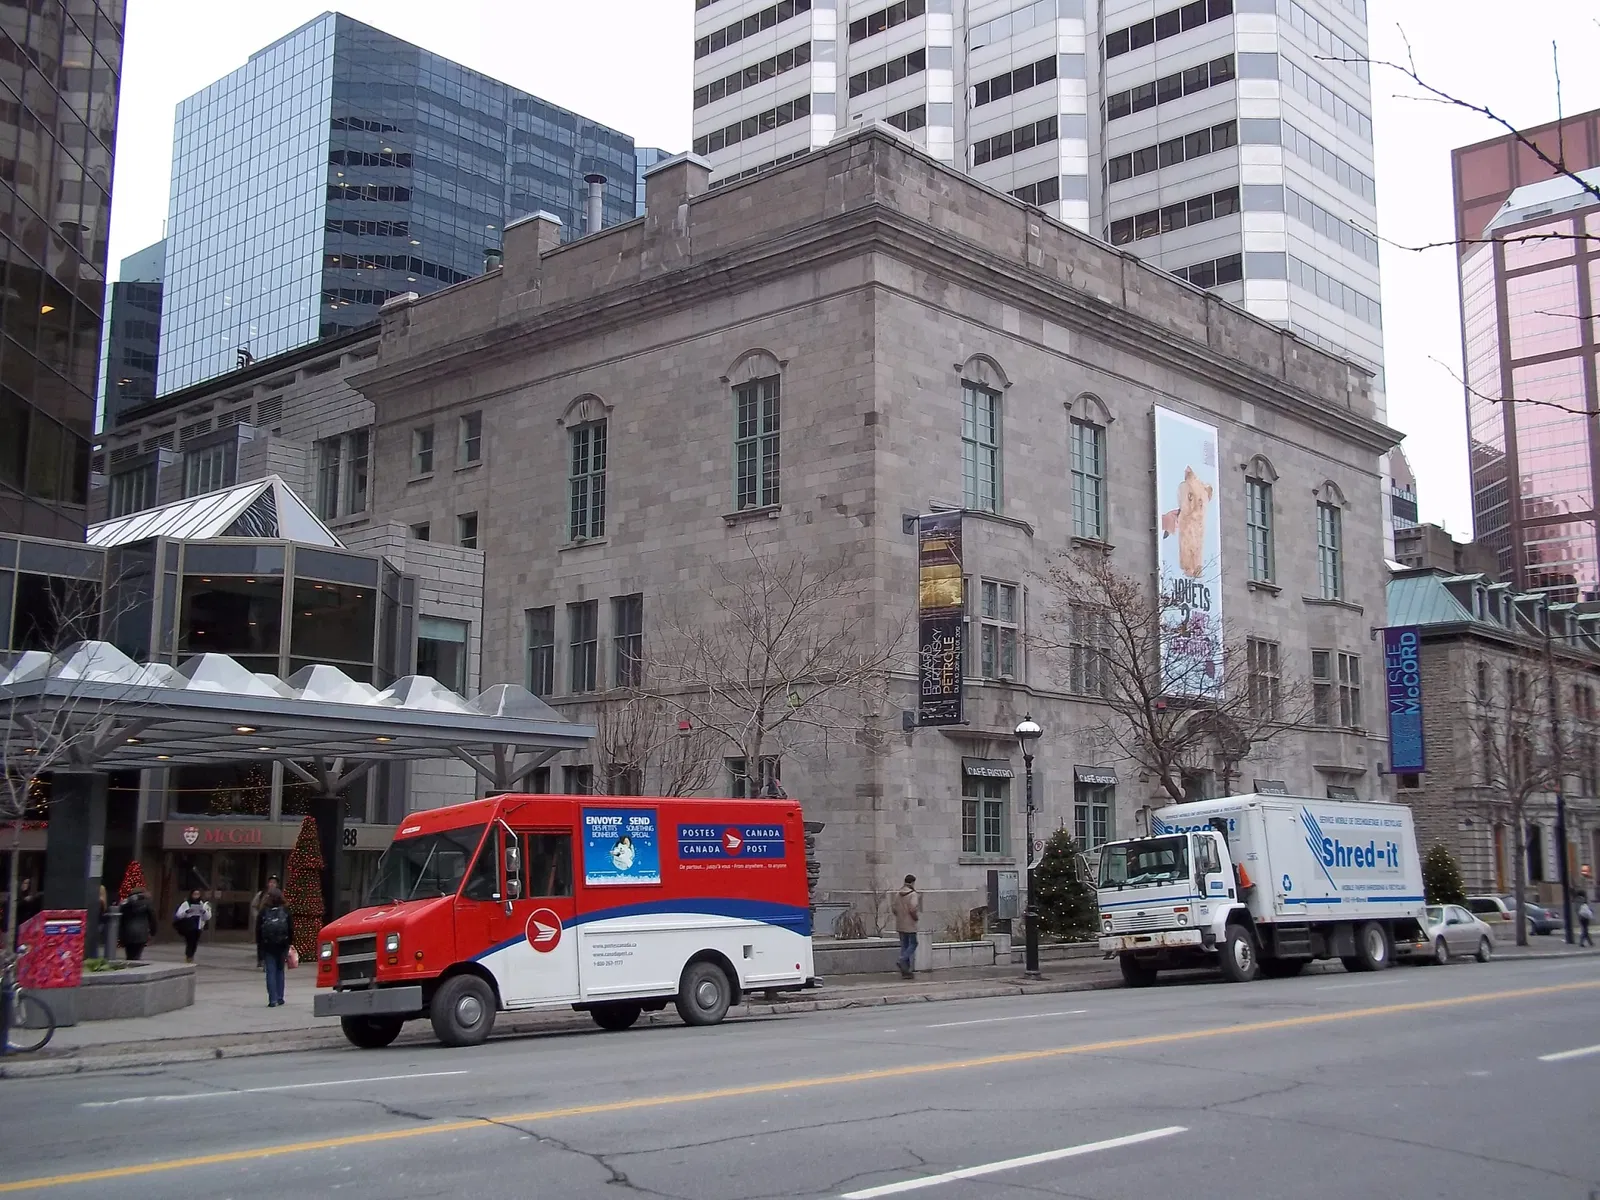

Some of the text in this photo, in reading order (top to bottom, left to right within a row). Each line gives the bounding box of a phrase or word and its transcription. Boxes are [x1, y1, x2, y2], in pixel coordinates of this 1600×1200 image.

[1172, 578, 1211, 612] JOUETS
[922, 644, 933, 695] EDWARD
[1400, 632, 1420, 715] McCORD
[586, 816, 623, 825] ENVOYEZ
[629, 816, 650, 825] SEND
[204, 828, 262, 844] McGill
[682, 829, 780, 837] POSTES CANADA
[683, 845, 767, 853] CANADA POST
[1322, 837, 1398, 868] Shred-it
